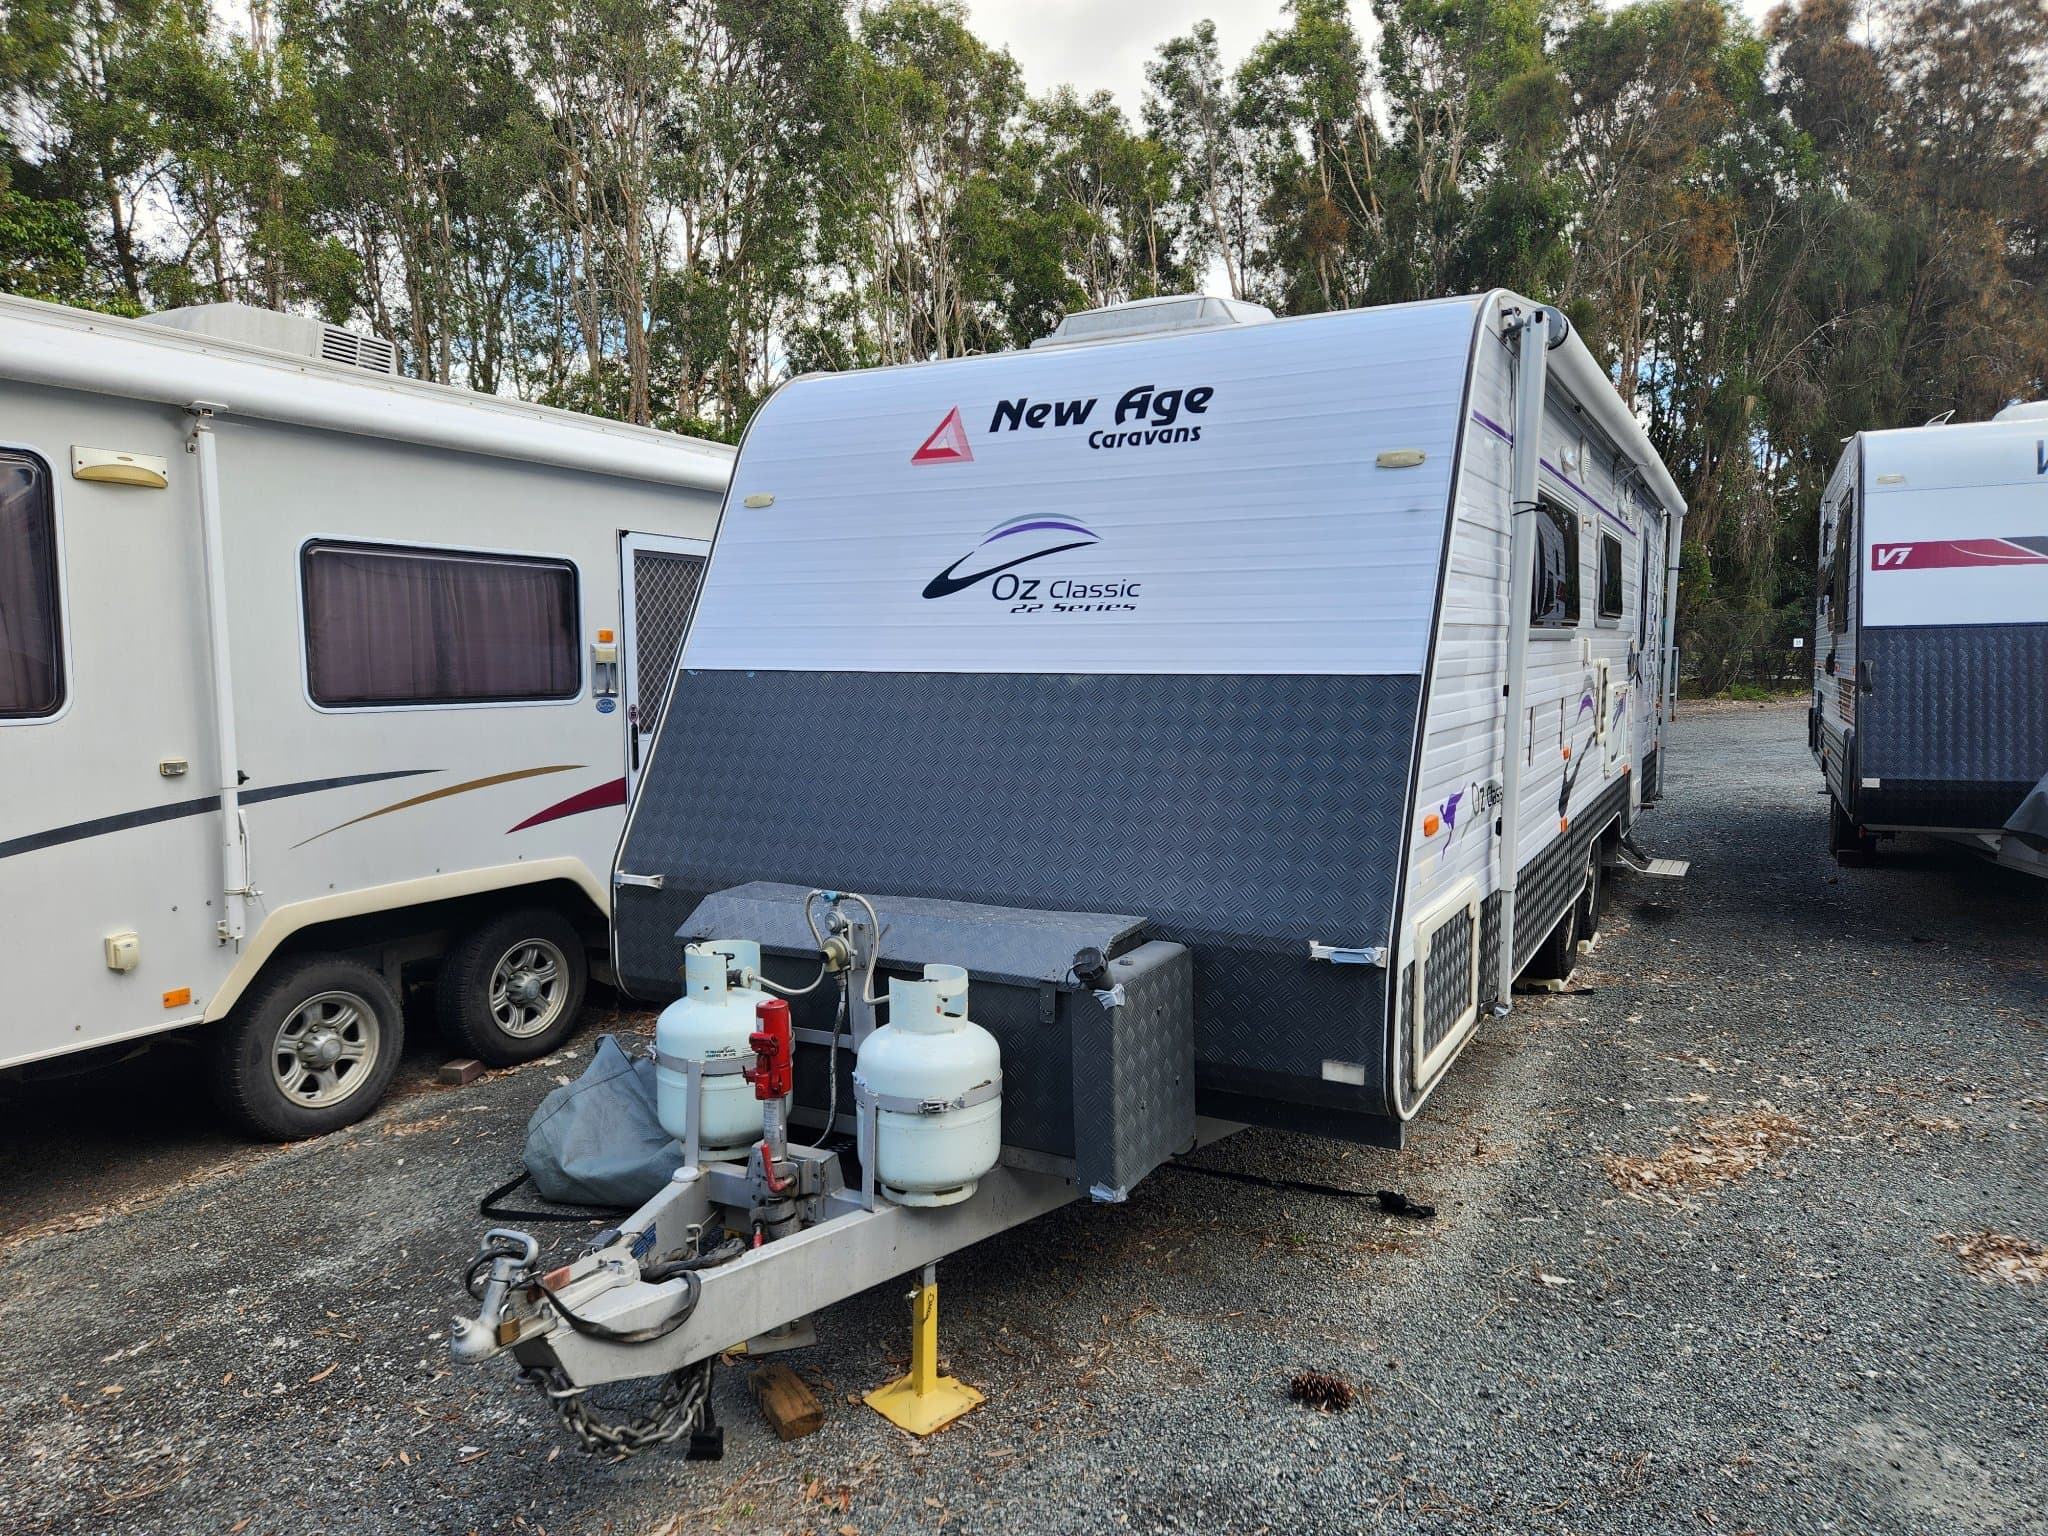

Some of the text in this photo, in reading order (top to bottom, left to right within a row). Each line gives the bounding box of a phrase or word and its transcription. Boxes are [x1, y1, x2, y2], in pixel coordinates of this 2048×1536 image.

[989, 384, 1215, 433] New Age
[1088, 425, 1202, 450] Caravans
[1877, 547, 1913, 566] V1
[991, 573, 1142, 601] Oz Classic
[1010, 601, 1137, 614] 22 Series
